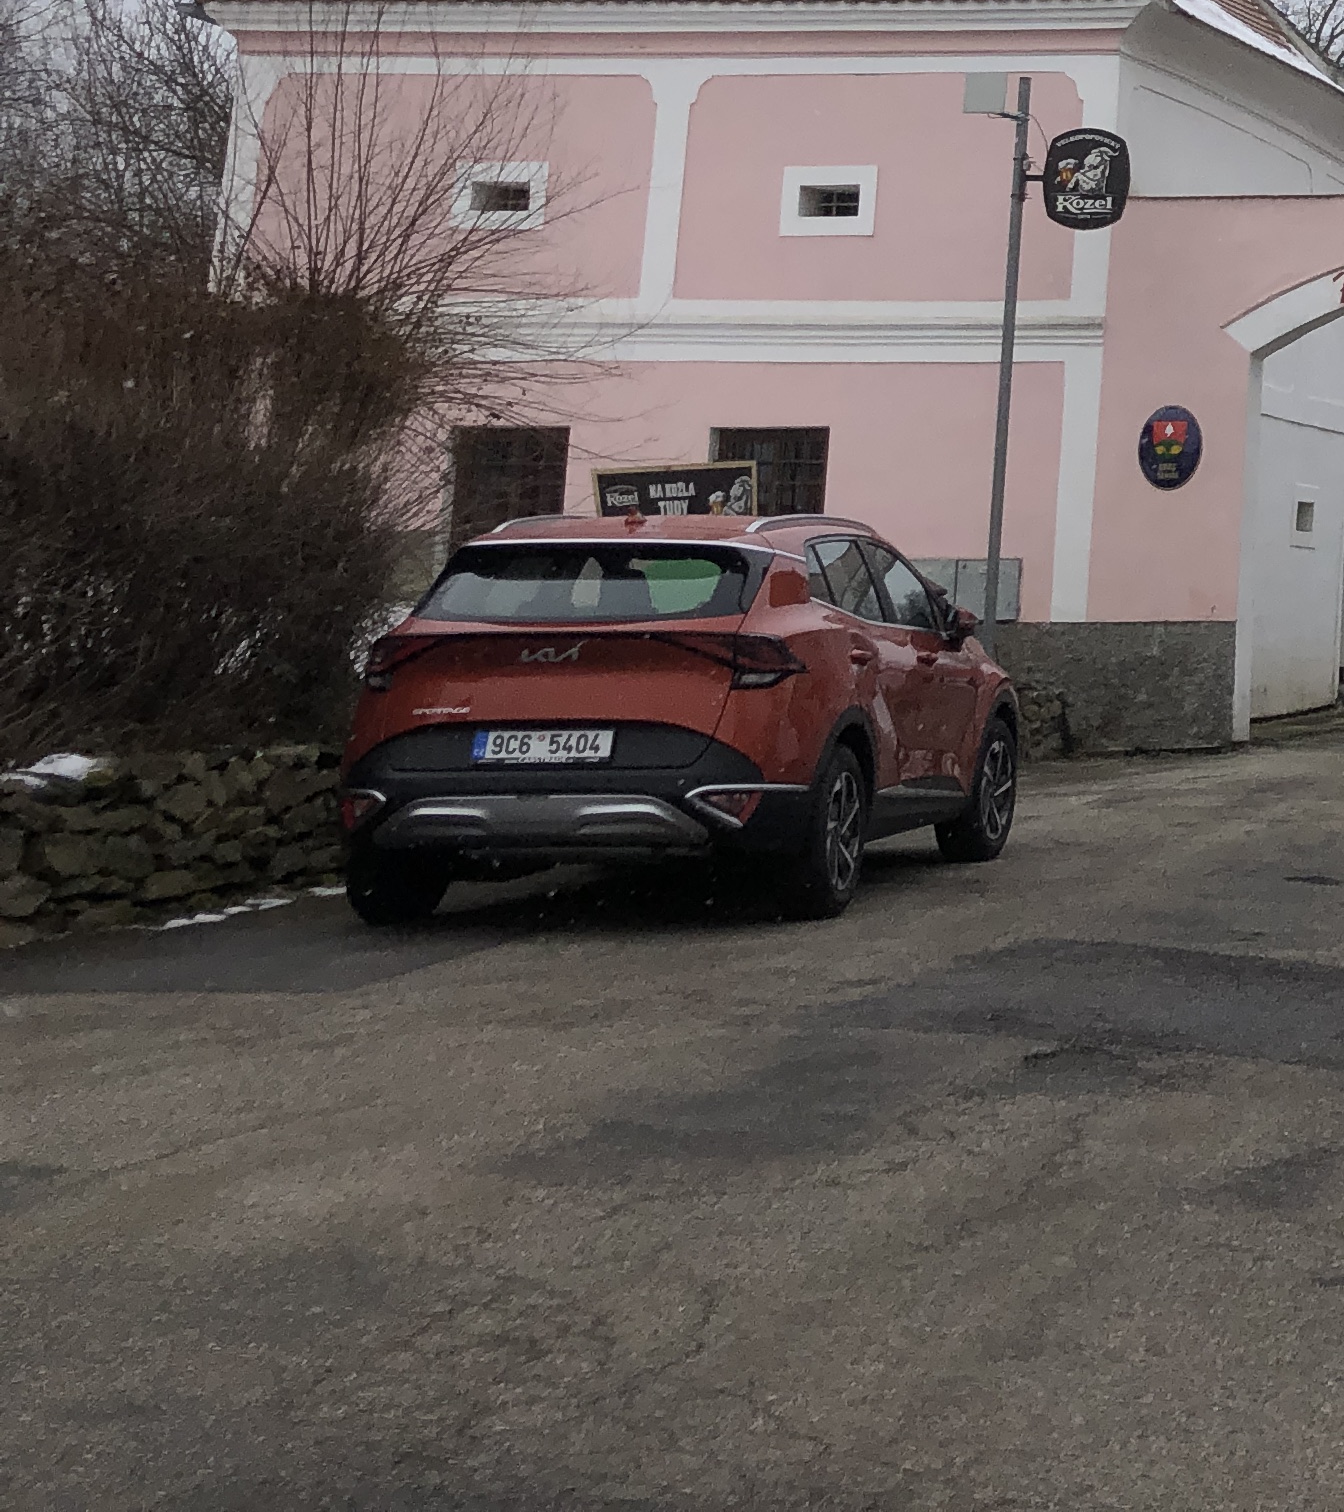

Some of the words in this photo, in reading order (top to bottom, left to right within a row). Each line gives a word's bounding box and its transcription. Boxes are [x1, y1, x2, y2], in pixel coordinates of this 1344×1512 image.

[1056, 195, 1113, 213] Kozel
[649, 484, 663, 498] NA
[665, 482, 696, 498] KOZLA
[606, 492, 639, 506] Kozel
[491, 734, 532, 755] 9C6
[548, 733, 600, 755] 5404
